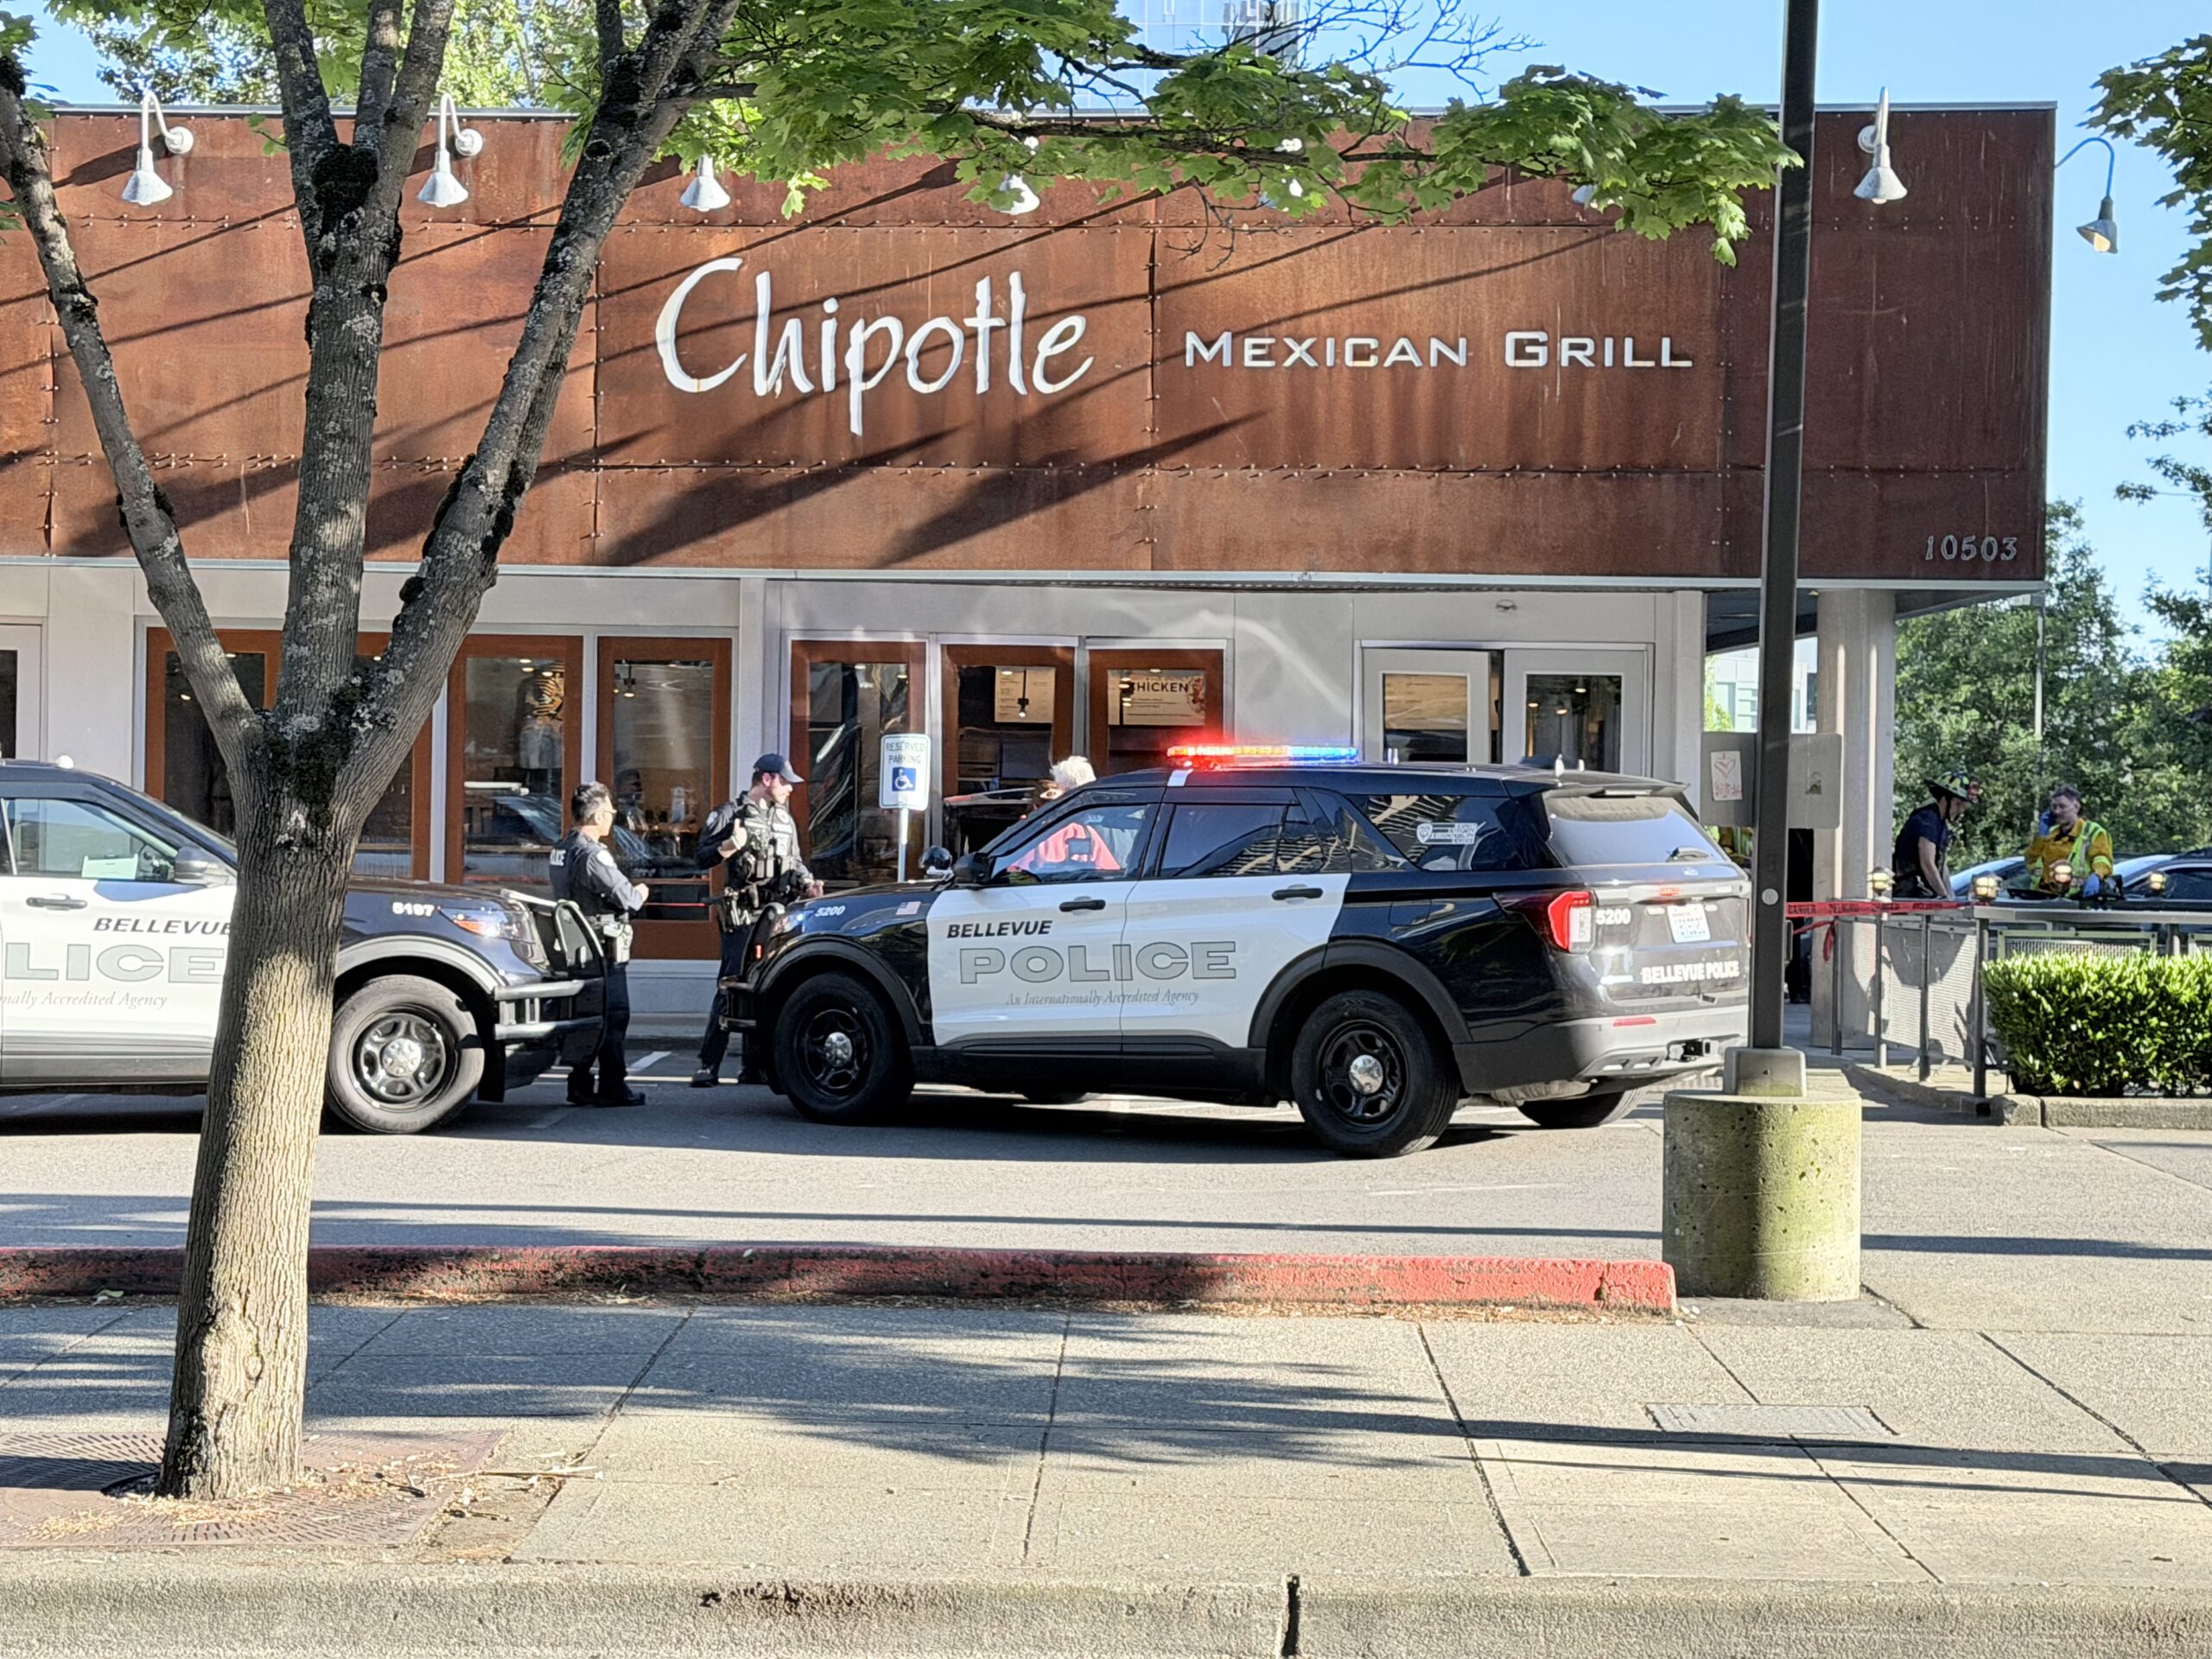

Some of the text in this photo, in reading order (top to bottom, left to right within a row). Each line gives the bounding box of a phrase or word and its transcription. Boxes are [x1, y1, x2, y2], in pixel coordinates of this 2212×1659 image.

[655, 257, 1094, 436] Chipotle
[1925, 535, 2018, 562] 10503
[1130, 682, 1189, 693] HICKEN
[886, 741, 925, 752] RESERVED
[888, 754, 922, 765] PARNG
[815, 906, 846, 917] 5200
[1595, 908, 1632, 925] 5200
[93, 918, 232, 936] BELLEVUE
[947, 920, 1052, 938] BELLEVUE
[960, 941, 1236, 984] POLICE
[1642, 961, 1739, 985] BELLEVUE POLICE
[41, 990, 116, 1006] Accredited
[118, 991, 167, 1009] Agency
[1006, 988, 1199, 1007] An Internationally Accredited Agency
